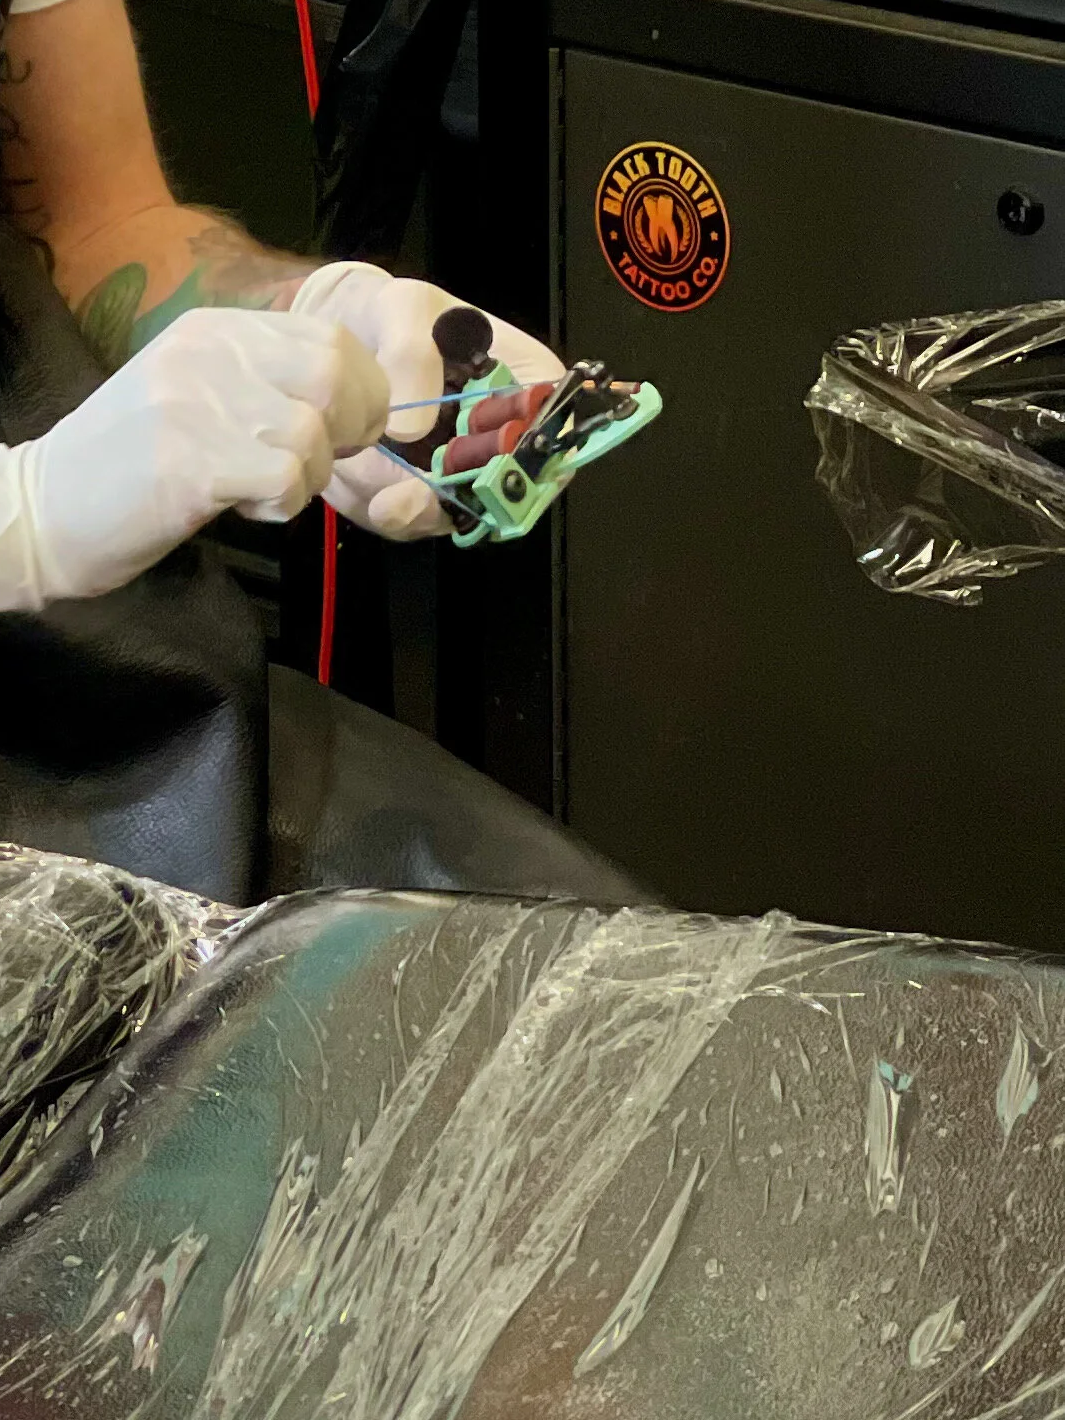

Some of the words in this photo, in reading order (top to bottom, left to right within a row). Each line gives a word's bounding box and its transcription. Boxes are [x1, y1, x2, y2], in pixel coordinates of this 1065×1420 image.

[602, 152, 651, 217] BLACK
[655, 151, 718, 219] TOOTH
[618, 251, 691, 301] TATTOO
